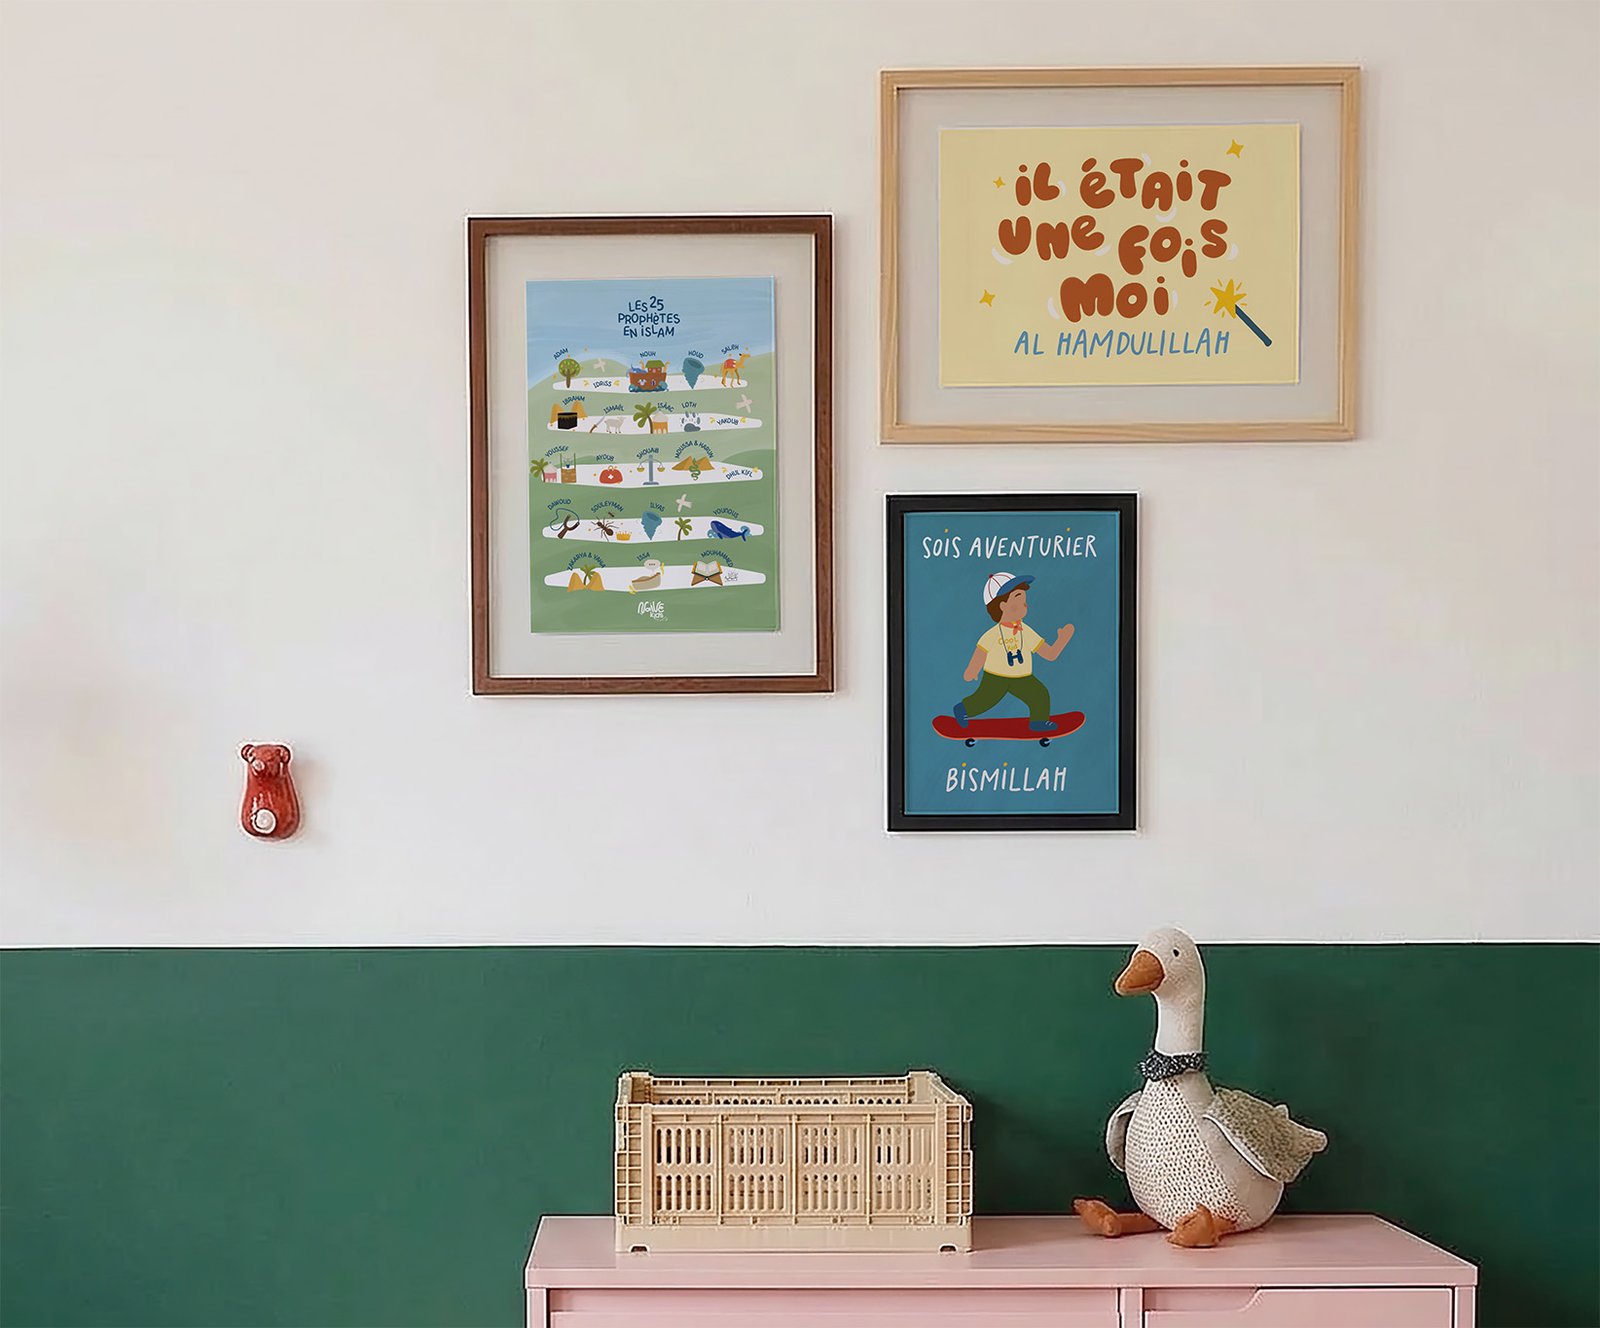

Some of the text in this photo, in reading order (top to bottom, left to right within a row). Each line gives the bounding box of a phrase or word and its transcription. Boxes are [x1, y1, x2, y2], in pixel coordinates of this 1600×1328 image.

[628, 295, 665, 313] LES 25
[623, 326, 638, 339] EN
[1013, 327, 1231, 358] AL HAMDULILLAH
[553, 347, 569, 360] ADAM
[639, 350, 657, 359] NOUH
[688, 350, 705, 359] HOUD
[681, 401, 697, 409] LOTH
[716, 417, 740, 426] YAKOUB
[544, 445, 569, 458] YOUSSEF
[674, 440, 693, 459] MOUSSA
[595, 453, 615, 462] AYOUB
[725, 469, 740, 480] DHUL
[591, 500, 625, 513] SOULEYMAN
[636, 551, 651, 562] ISSA
